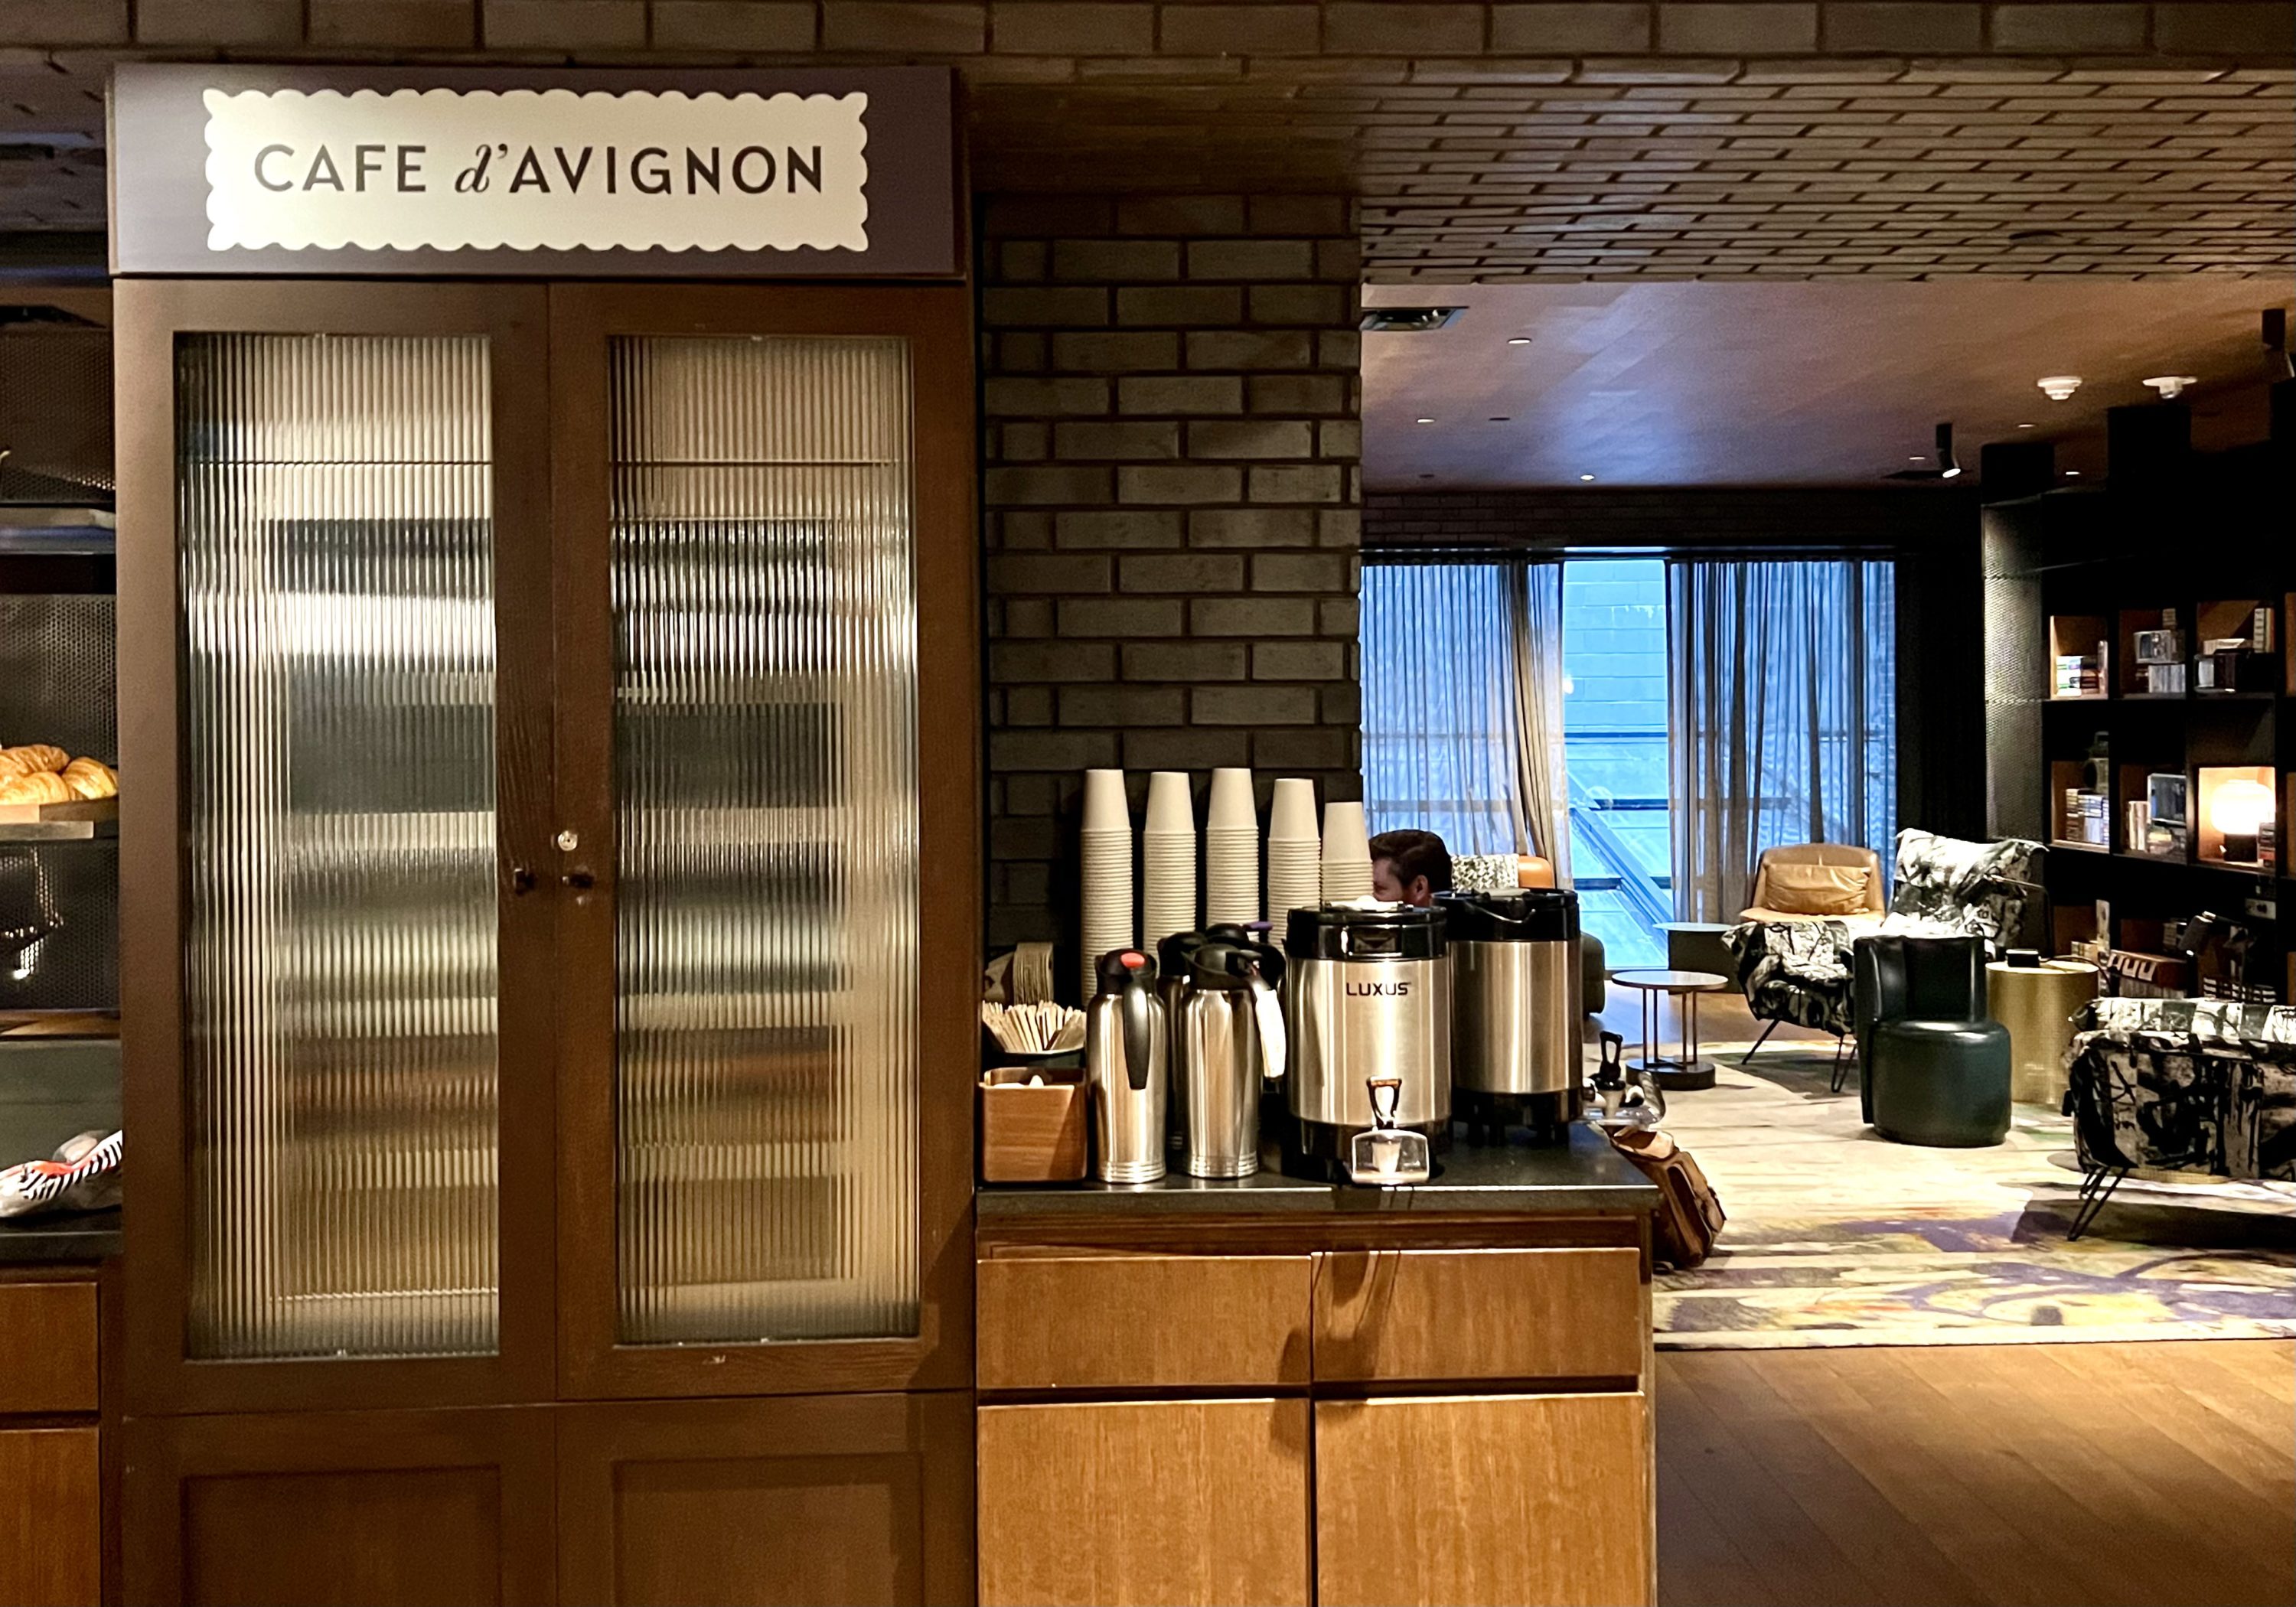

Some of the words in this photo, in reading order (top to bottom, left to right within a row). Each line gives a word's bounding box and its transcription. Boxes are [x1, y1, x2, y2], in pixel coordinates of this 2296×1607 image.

[254, 144, 427, 193] CAFE
[454, 142, 823, 195] d'AVIGNON
[1345, 982, 1410, 996] LUXUS
